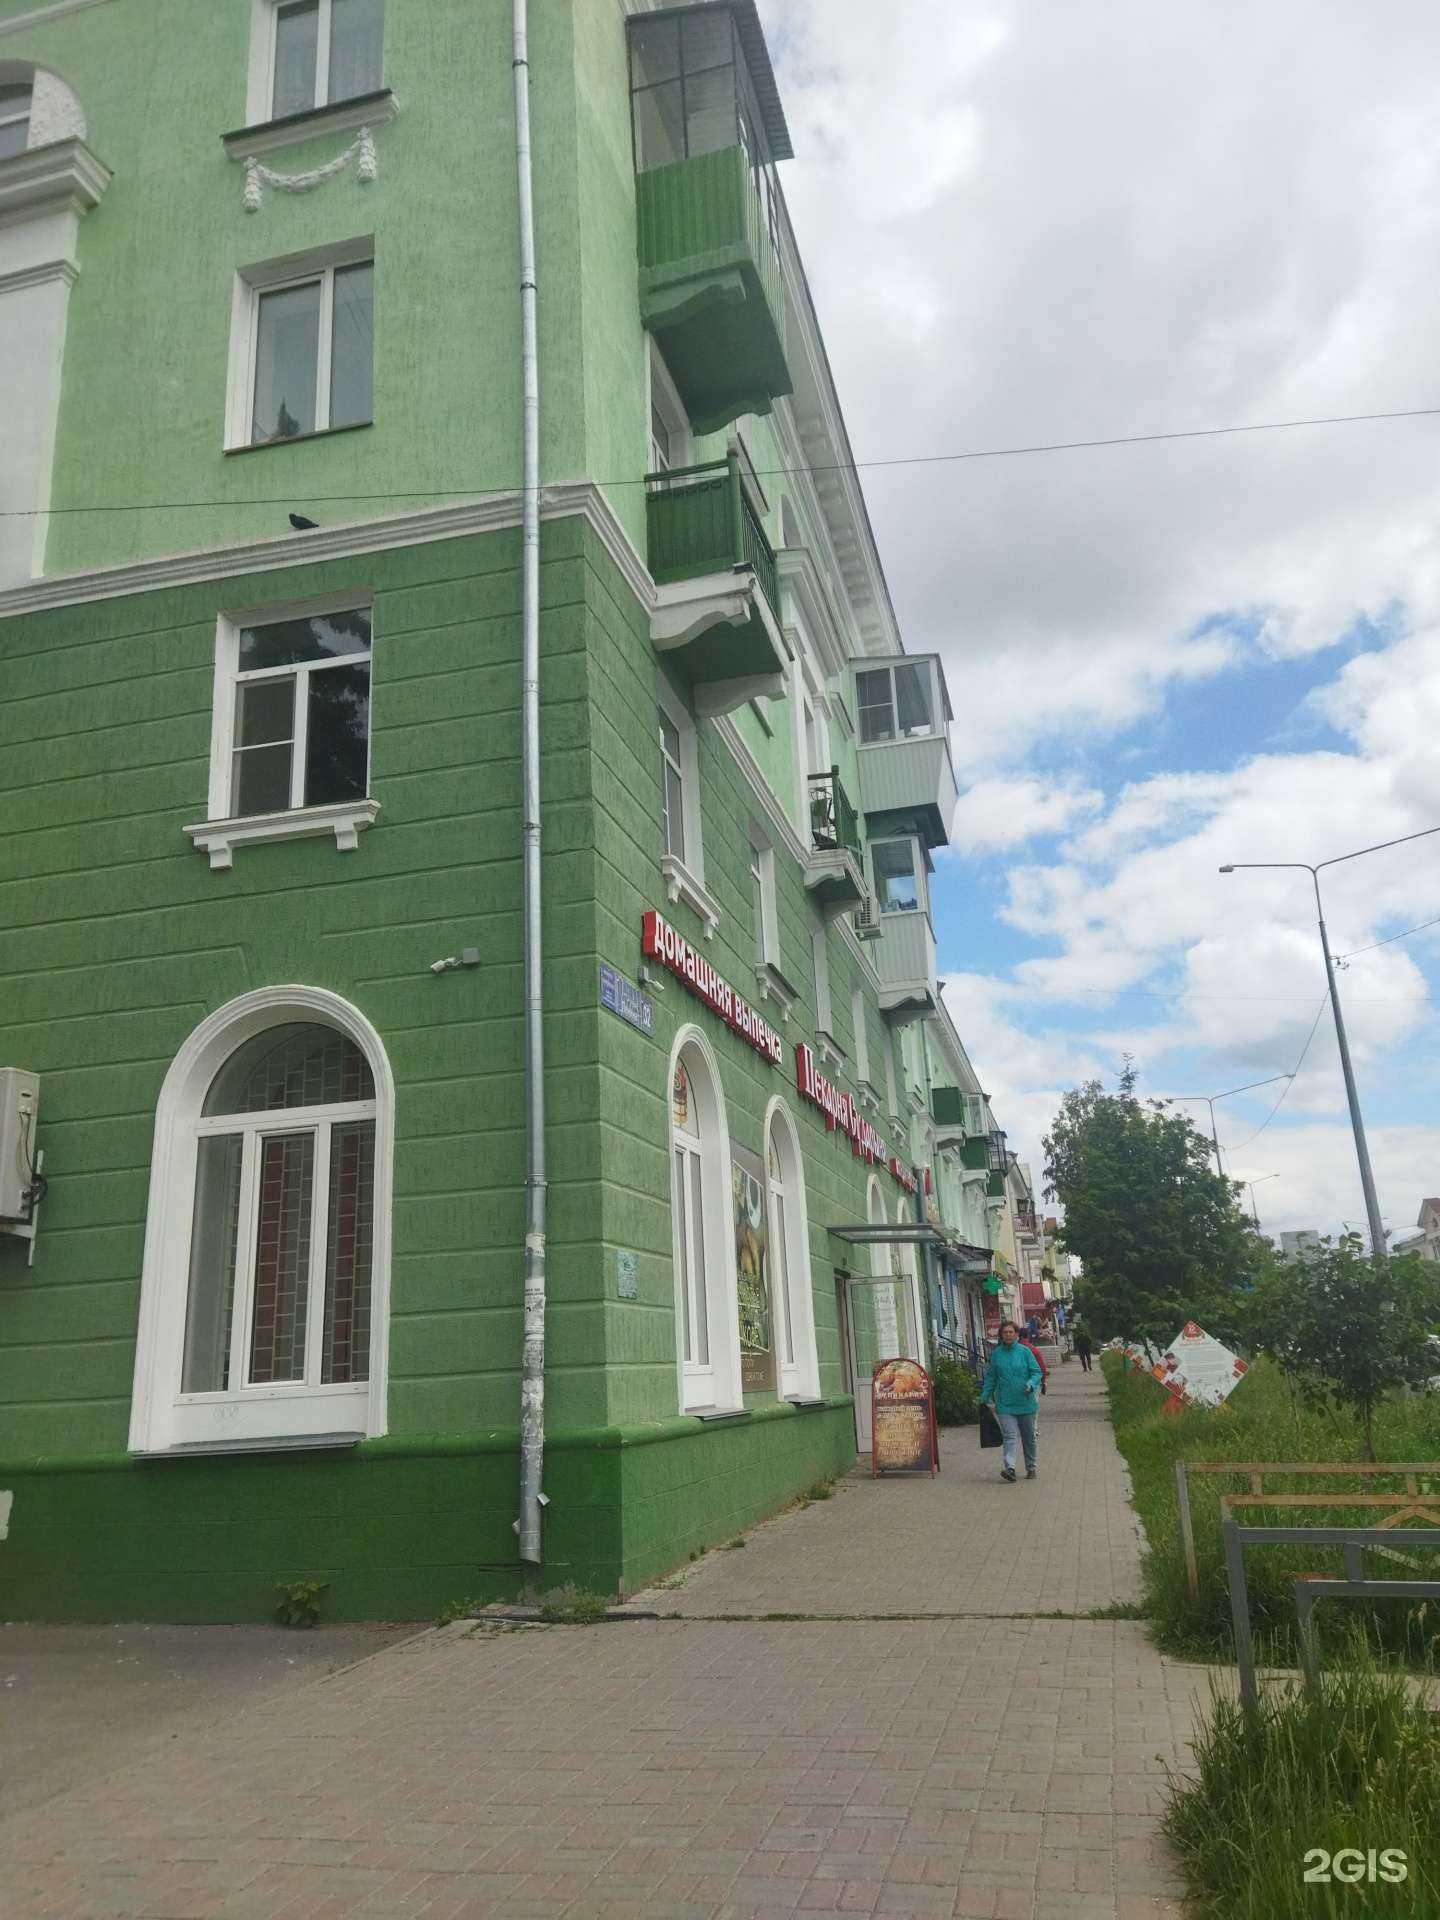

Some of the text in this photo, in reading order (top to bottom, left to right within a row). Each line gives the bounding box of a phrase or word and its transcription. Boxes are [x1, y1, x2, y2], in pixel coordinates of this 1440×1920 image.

[654, 911, 732, 1018] домашняя
[735, 994, 783, 1065] выпечка
[803, 1043, 849, 1131] Пекарня
